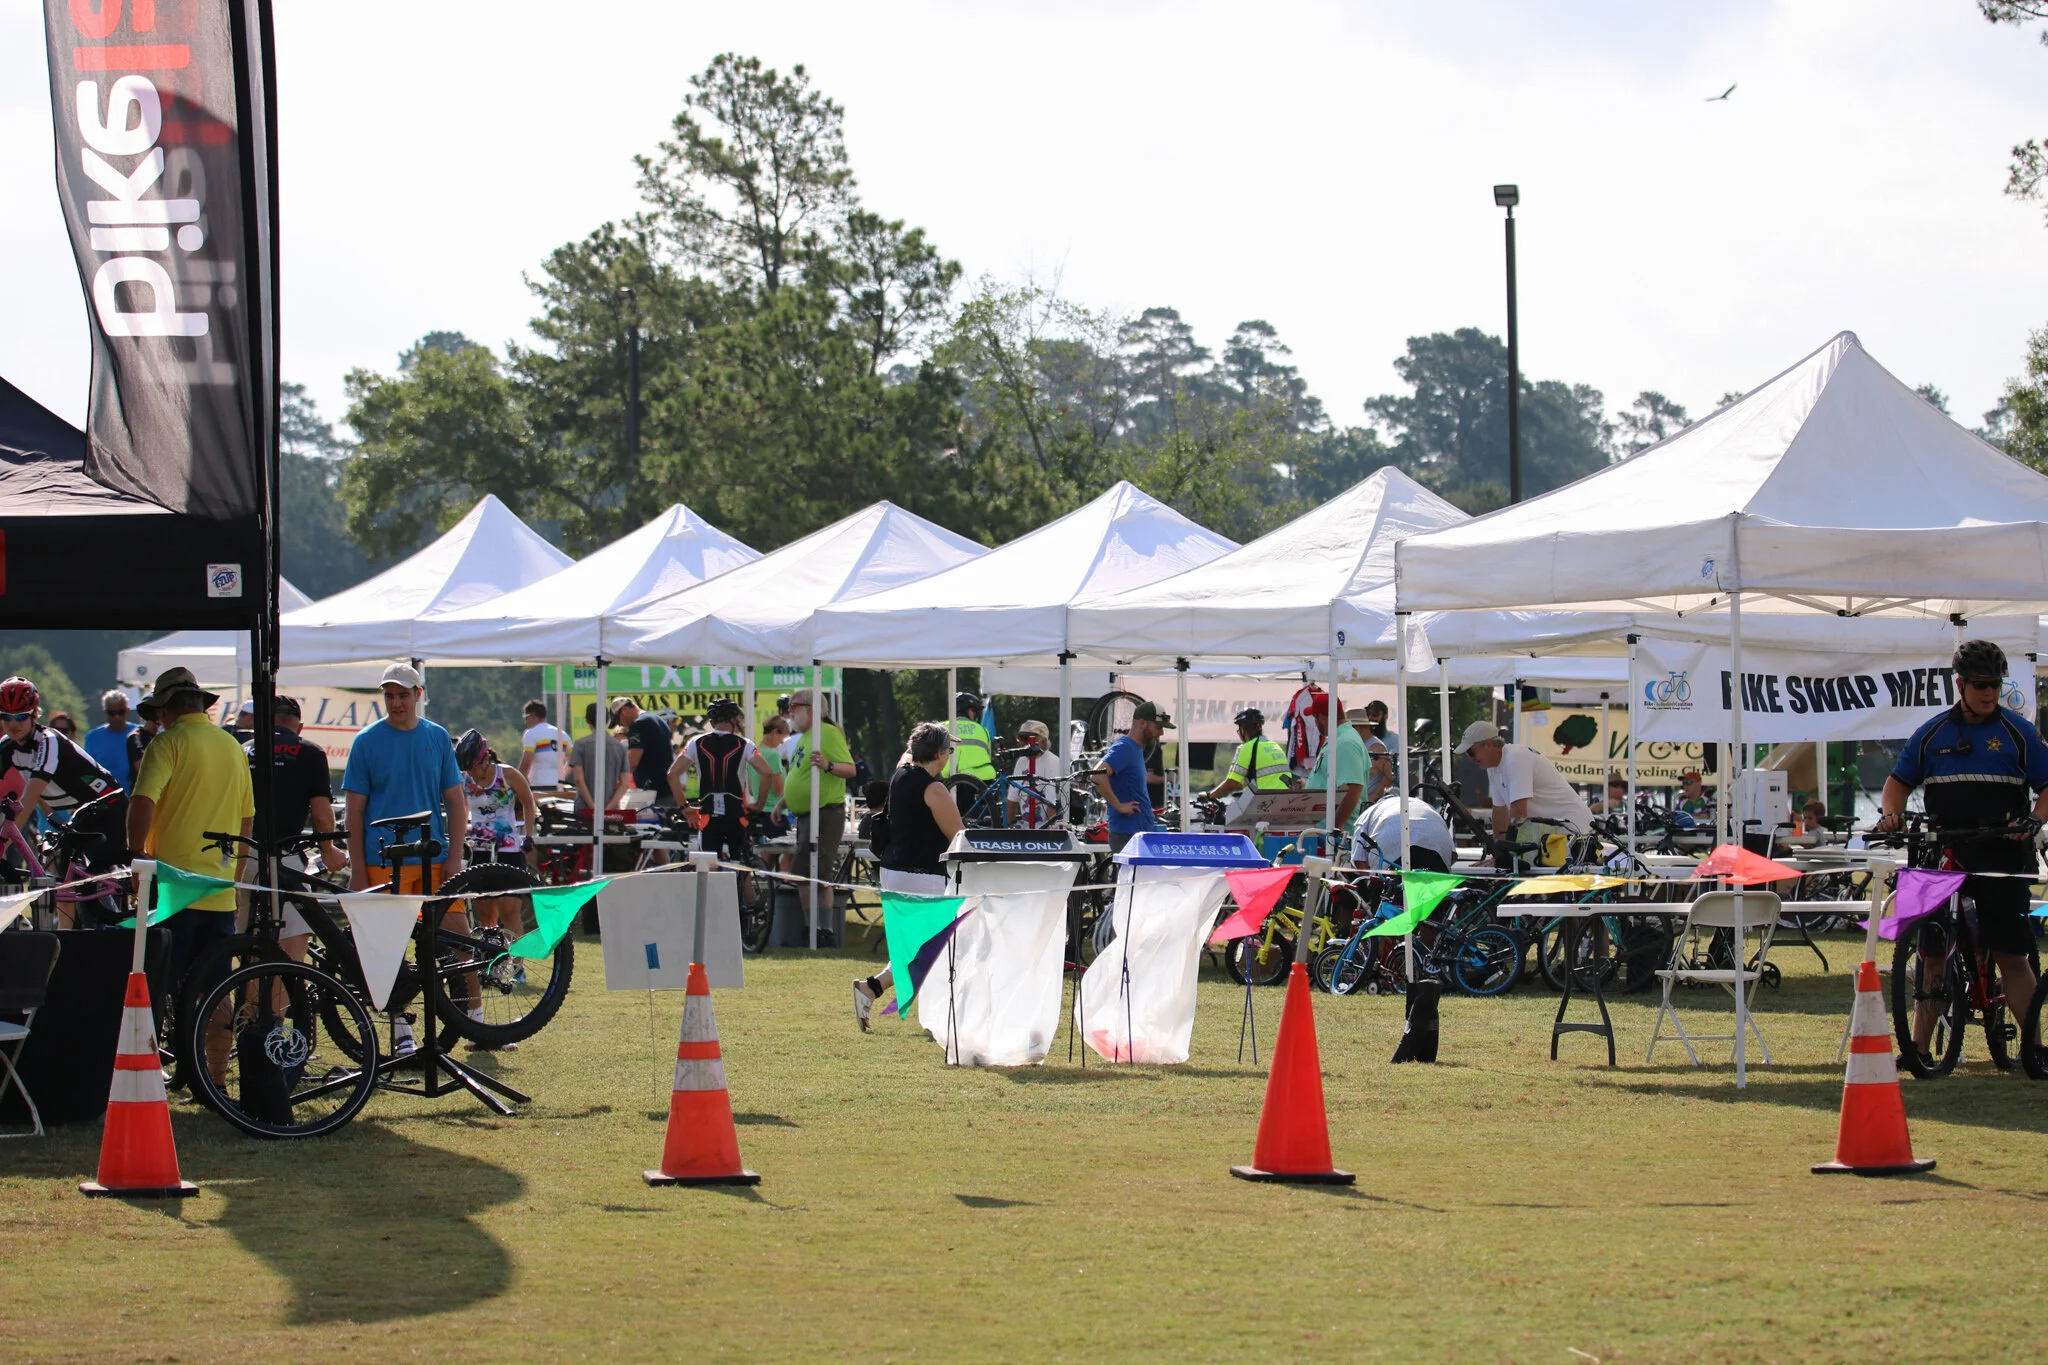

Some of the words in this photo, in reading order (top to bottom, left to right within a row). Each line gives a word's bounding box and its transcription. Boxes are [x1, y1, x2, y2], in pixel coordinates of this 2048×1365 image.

[574, 669, 598, 679] BIK
[574, 680, 600, 689] RU
[773, 674, 806, 685] RUN
[1785, 675, 1878, 714] SWAP
[1882, 667, 1955, 707] MEET
[1556, 763, 1621, 776] oodlans
[971, 841, 1022, 850] TRASH
[1025, 841, 1065, 850] ONLY
